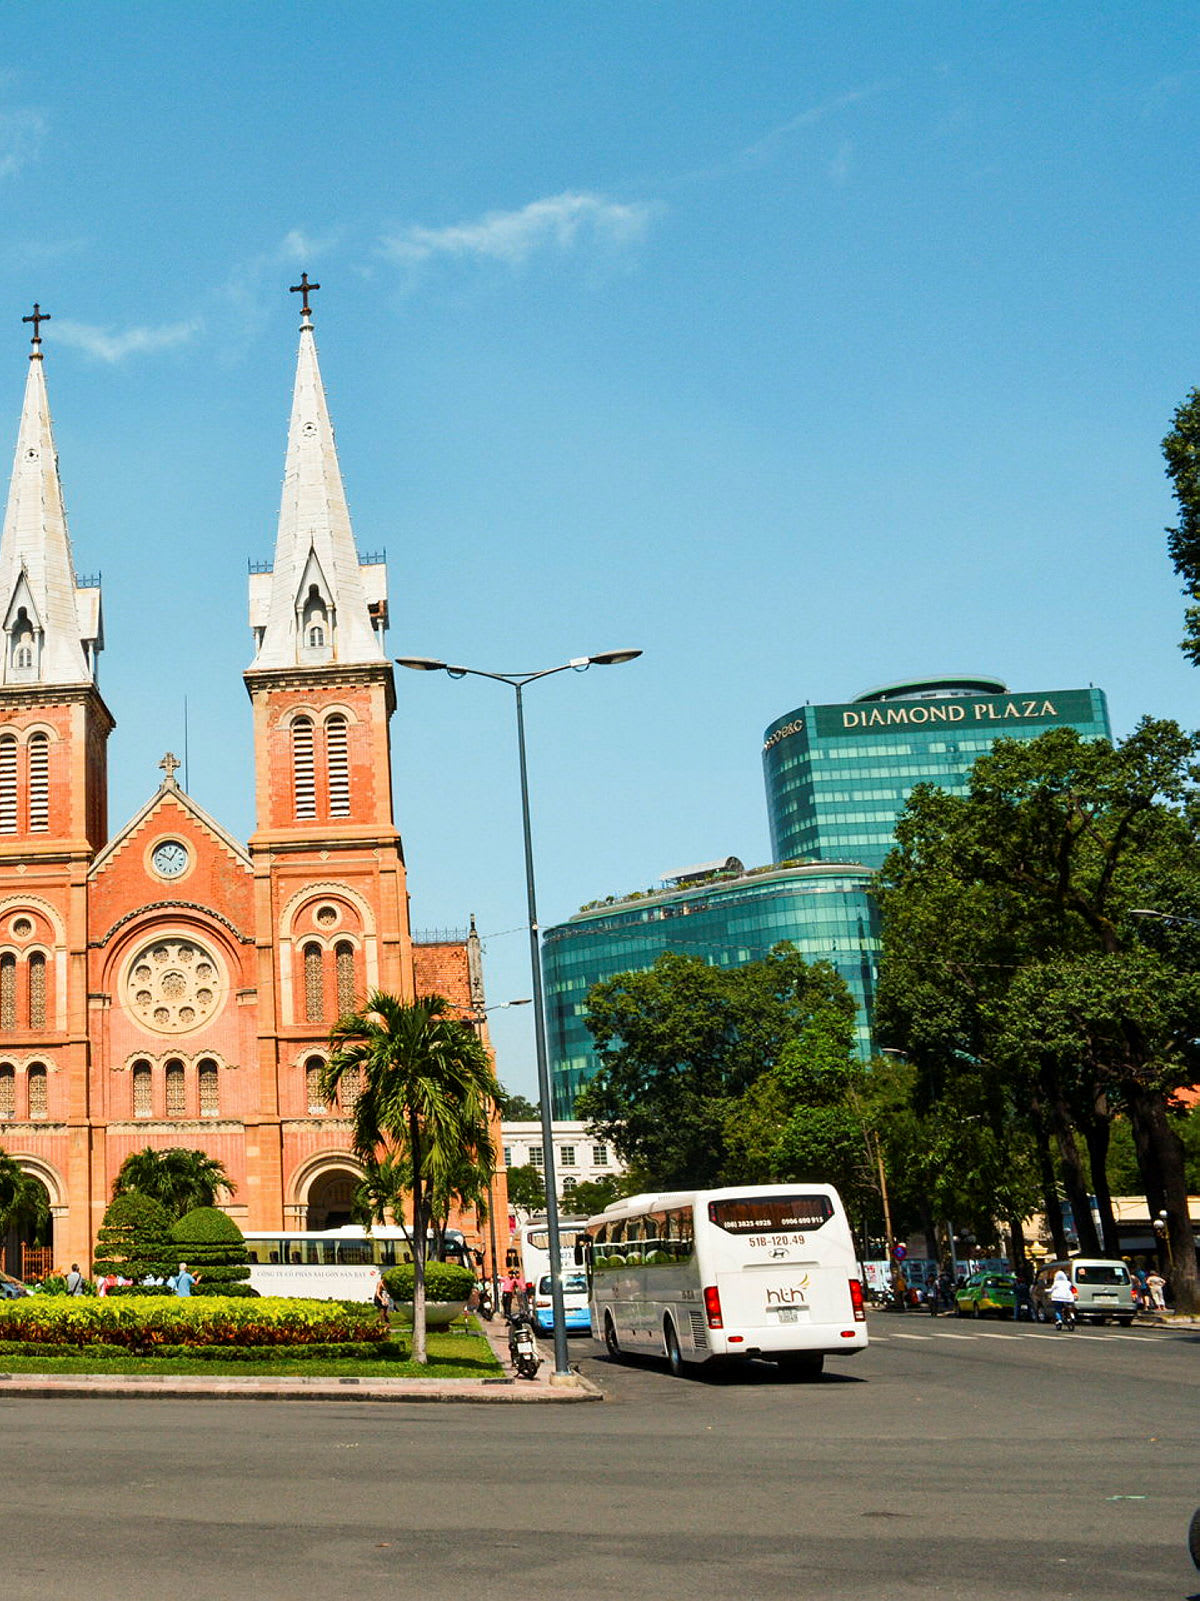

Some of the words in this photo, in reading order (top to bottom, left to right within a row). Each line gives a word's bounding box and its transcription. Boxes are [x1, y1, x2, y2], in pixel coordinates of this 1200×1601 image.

[842, 705, 966, 728] DIAMOND
[973, 700, 1058, 720] PLAZA
[749, 1235, 805, 1247] 51B-120.49
